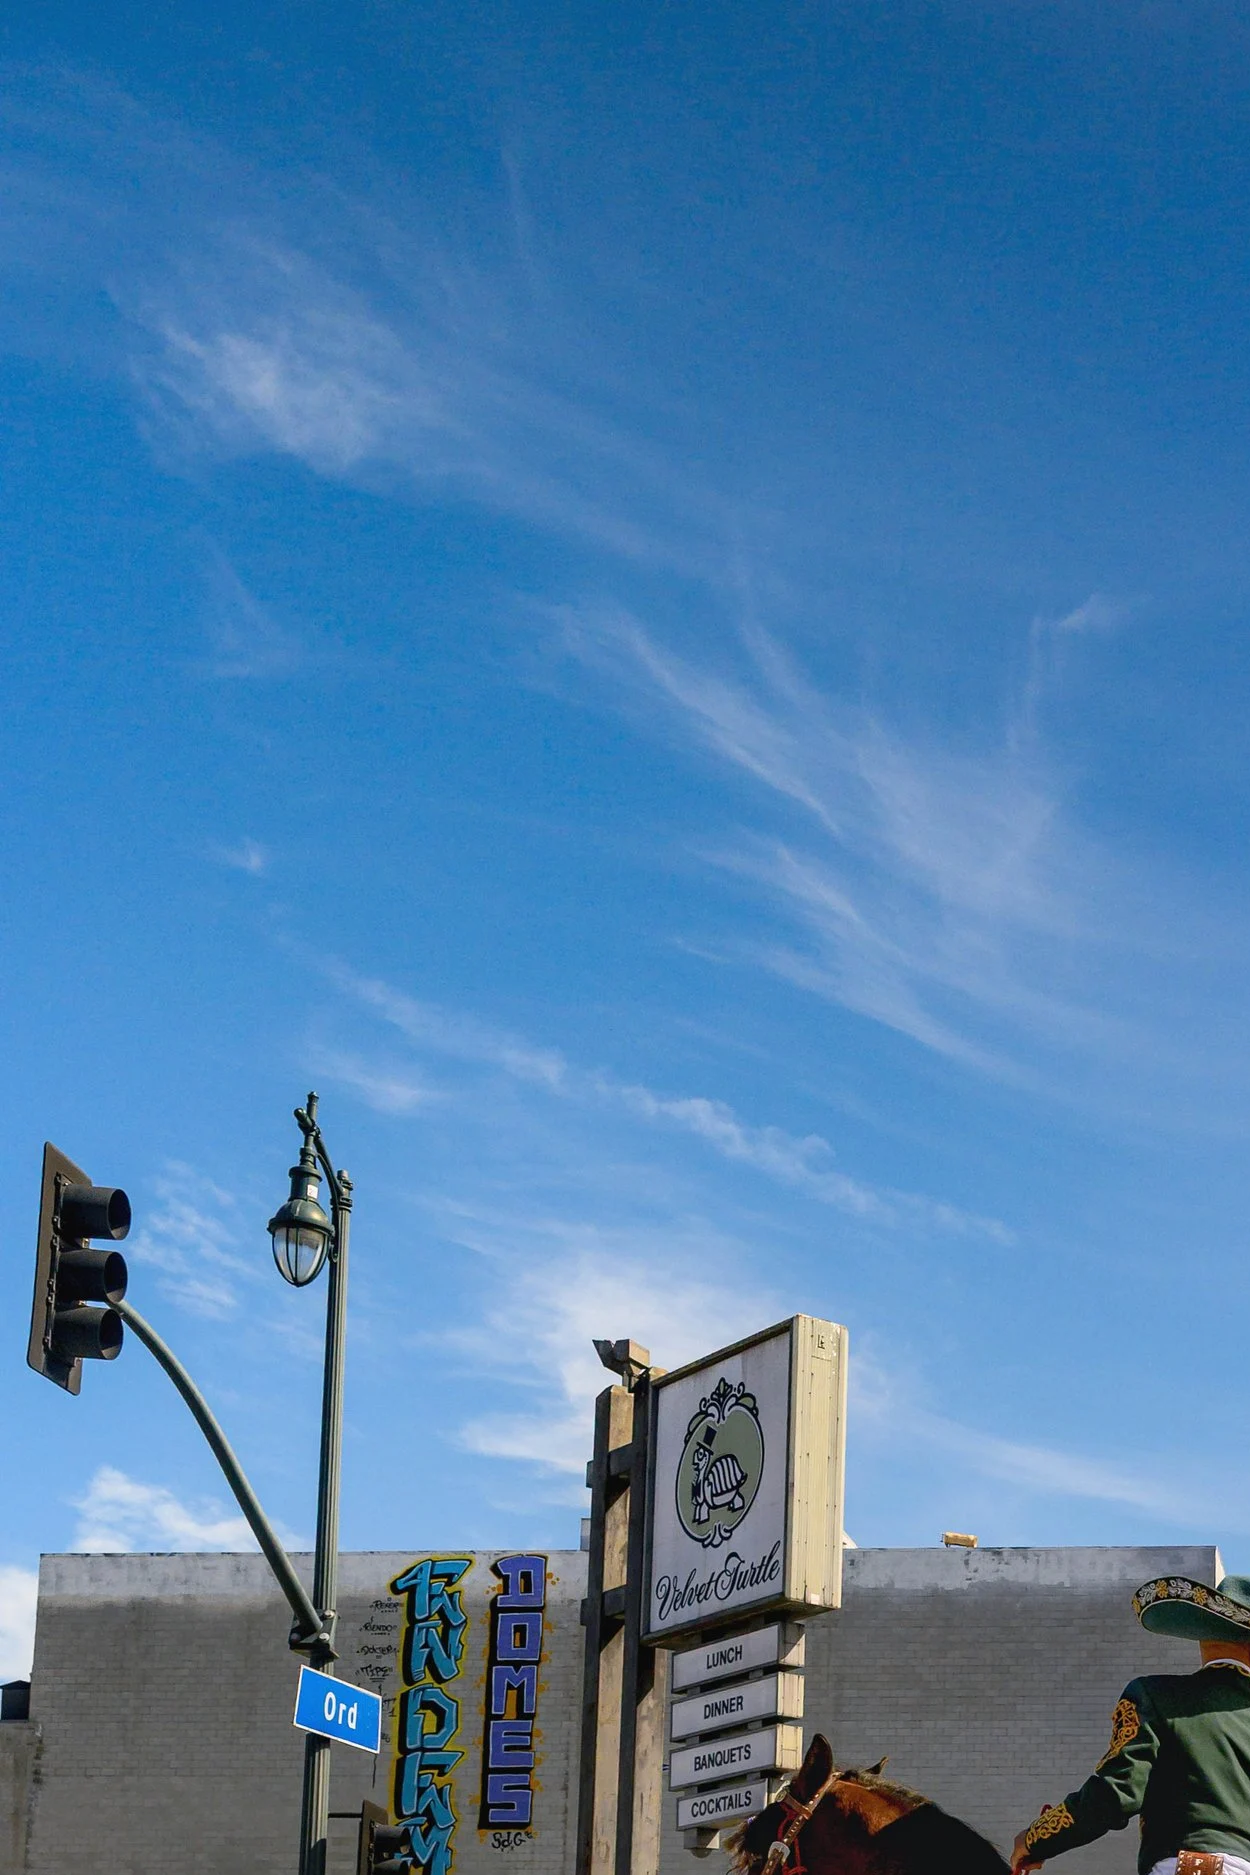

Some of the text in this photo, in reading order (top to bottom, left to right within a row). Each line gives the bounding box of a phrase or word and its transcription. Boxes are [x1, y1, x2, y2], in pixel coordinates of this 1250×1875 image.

[656, 1540, 780, 1620] Velvet Turtle
[706, 1645, 743, 1669] LUNCH
[485, 1554, 547, 1826] DOMES
[324, 1691, 358, 1730] Ord
[703, 1695, 744, 1720] DINNER
[694, 1744, 751, 1772] BANQUETS
[691, 1790, 752, 1818] COCKTAILS
